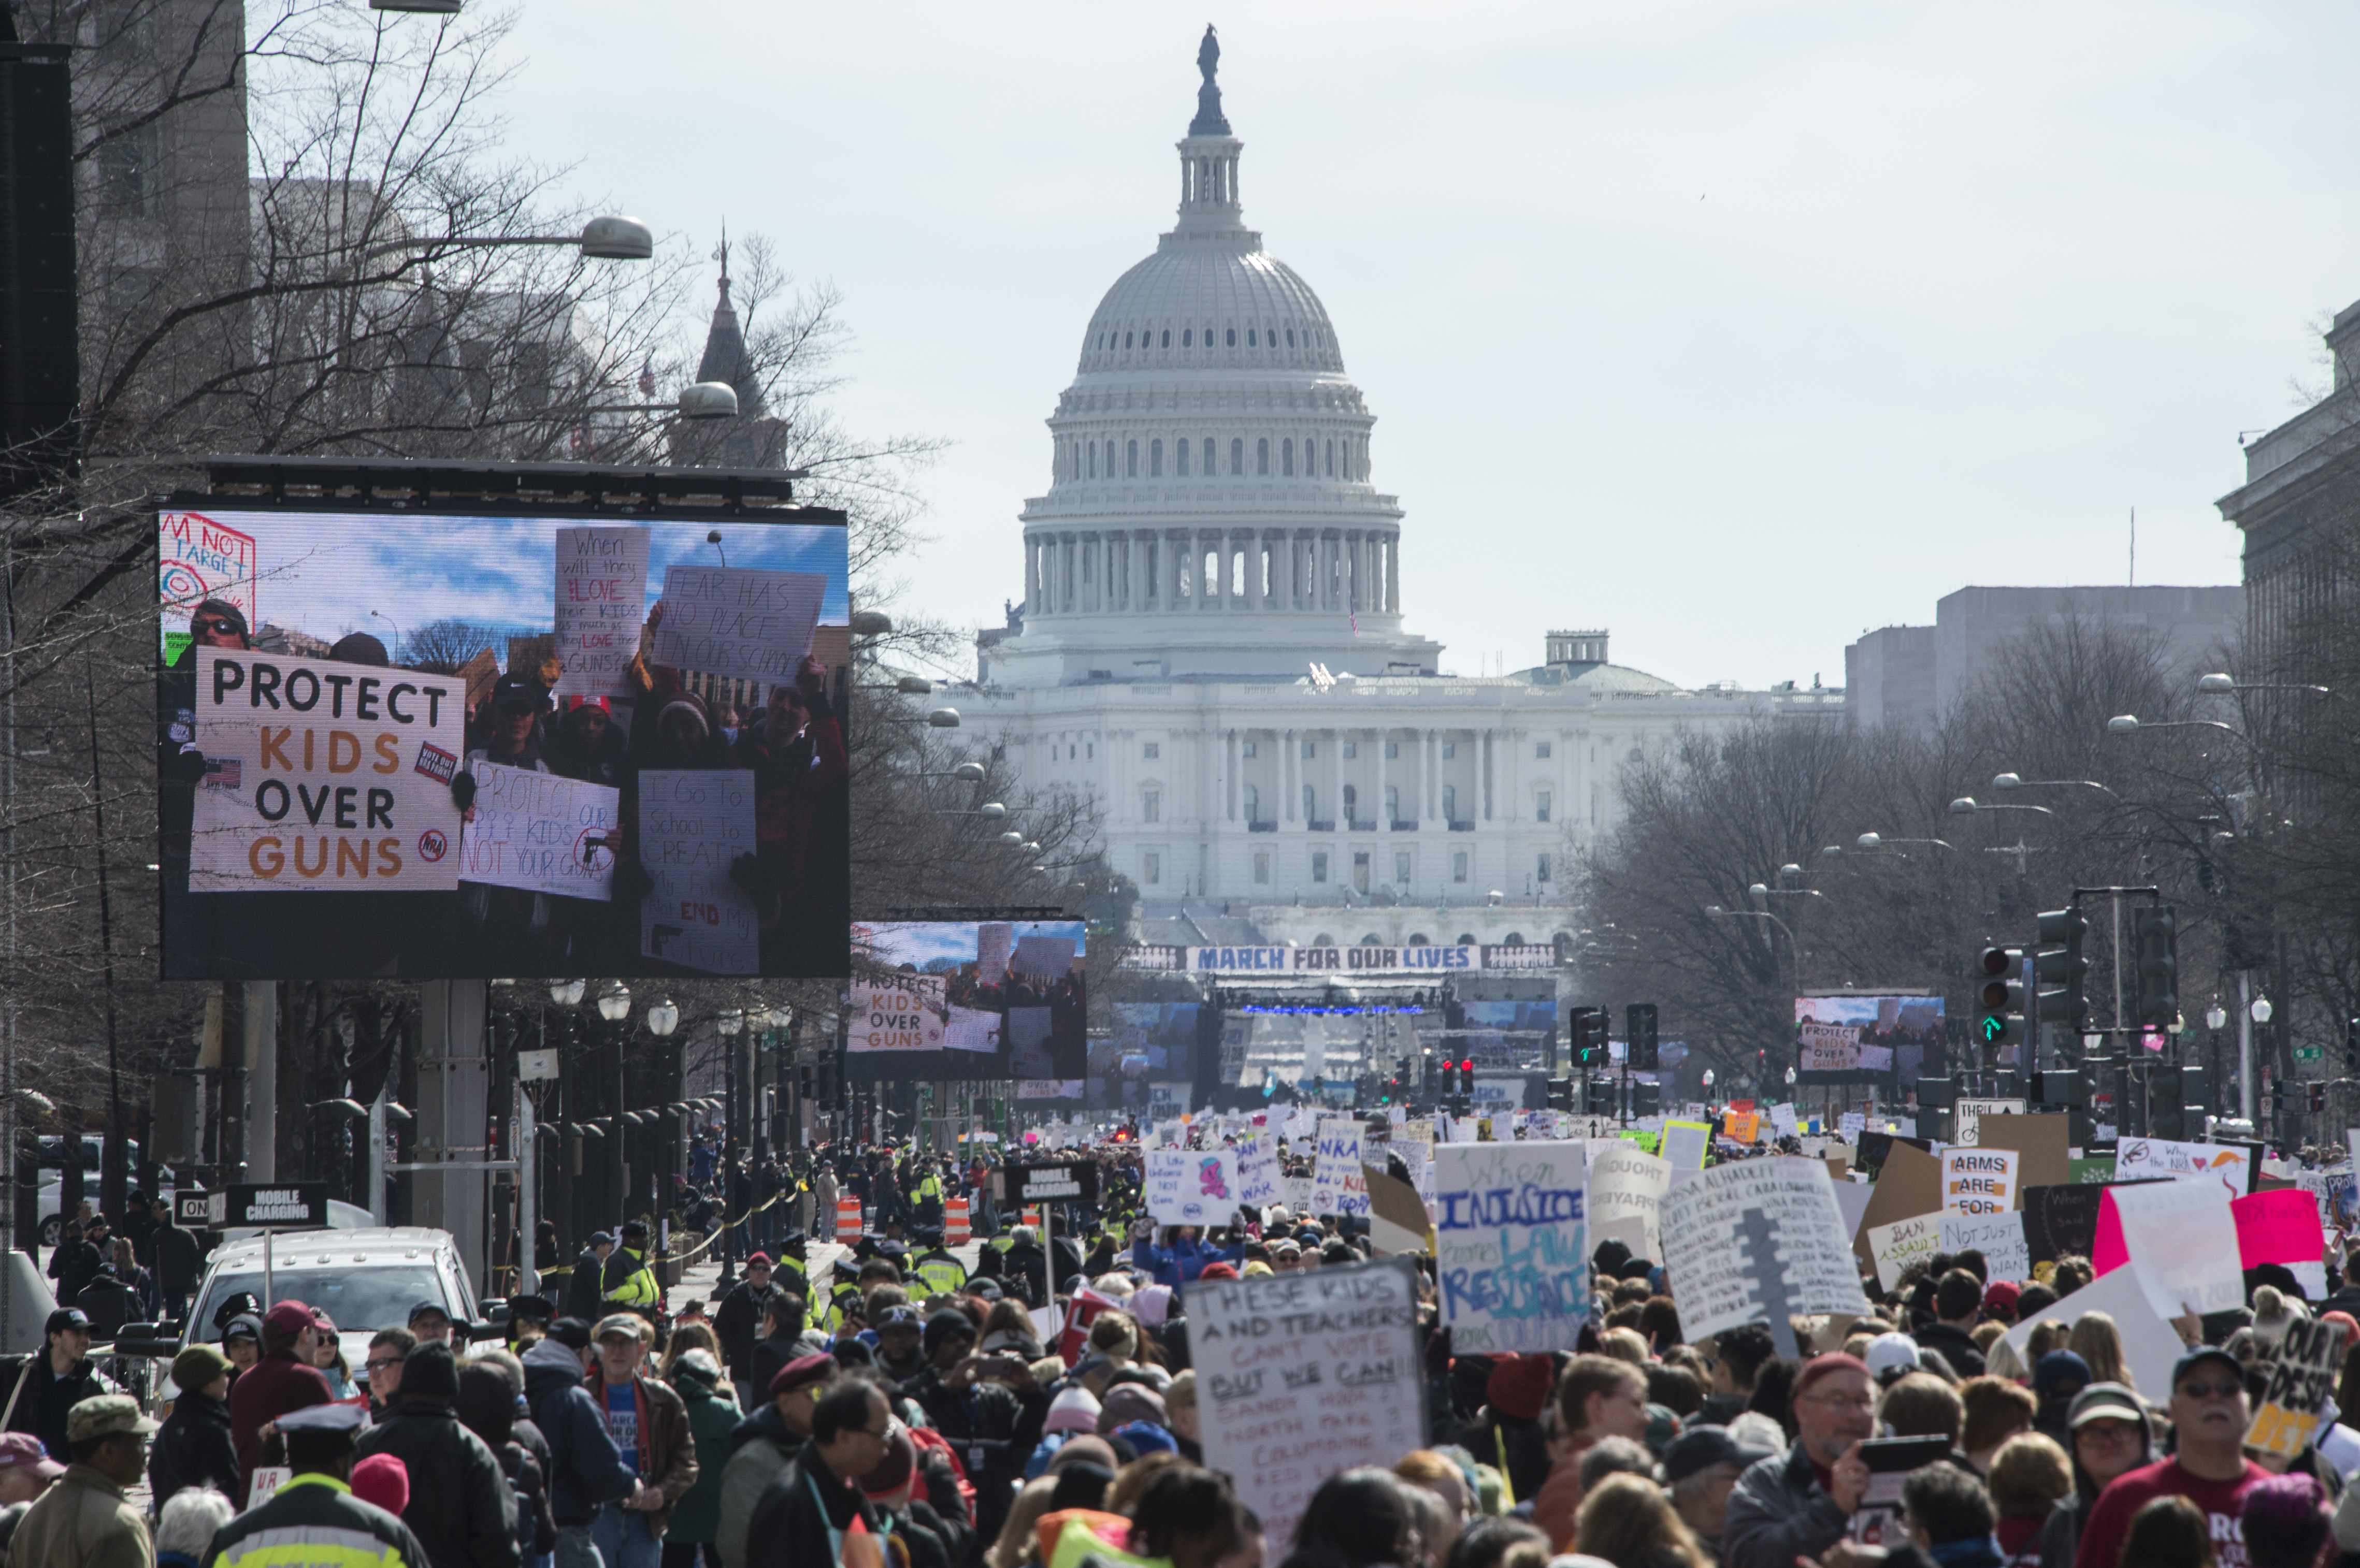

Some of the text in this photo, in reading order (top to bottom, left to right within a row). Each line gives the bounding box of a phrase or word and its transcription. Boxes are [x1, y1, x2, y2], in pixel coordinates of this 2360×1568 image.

[202, 526, 251, 564] NOT
[573, 529, 624, 557] When
[170, 537, 247, 579] TARGET
[562, 559, 636, 583] will they
[571, 578, 625, 602] LOVE
[668, 570, 789, 612] FEAR HAS
[599, 604, 637, 619] KIDS
[663, 601, 697, 626] NO
[710, 607, 780, 640] PLACE
[578, 619, 605, 630] much
[582, 633, 613, 648] LOVE
[660, 631, 690, 662] IN
[696, 638, 727, 667] OUR
[212, 659, 447, 727] PROTECT
[260, 727, 399, 774] KIDS
[423, 748, 454, 769] VOTE OUT
[476, 762, 582, 817] PROTECT
[645, 776, 668, 803] I
[256, 779, 394, 829] OVER
[579, 804, 608, 827] OUR
[527, 816, 573, 846] KIDS
[649, 809, 704, 834] School
[422, 835, 442, 853] NRA
[643, 840, 744, 867] CREATE
[249, 836, 402, 878] GUNS
[460, 839, 602, 880] NOT YOUR GUNS
[651, 869, 673, 896] My
[681, 901, 719, 925] END
[727, 908, 750, 939] My
[1198, 947, 1470, 969] MARCH FOR OUR LIVES
[855, 972, 941, 994] PROTECT
[872, 994, 923, 1011] KIDS
[871, 1012, 920, 1029] OVER
[868, 1032, 923, 1048] GUNS
[1805, 1027, 1855, 1039] PROTECT
[1815, 1038, 1846, 1048] KIDS
[1815, 1049, 1844, 1057] OVER
[1153, 1154, 1158, 1165] I
[1319, 1139, 1359, 1160] NRA
[2165, 1145, 2189, 1157] Why
[1459, 1149, 1564, 1187] When
[1954, 1156, 2005, 1171] ARMS
[2150, 1156, 2164, 1168] the
[2170, 1158, 2191, 1170] NRA
[1029, 1167, 1071, 1184] MOBILE
[1158, 1181, 1177, 1191] NOT
[1316, 1172, 1331, 1184] did
[1343, 1174, 1368, 1192] KIL
[1959, 1179, 1995, 1193] ARE
[255, 1190, 299, 1205] MOBILE
[1022, 1181, 1081, 1199] CHARGING
[1241, 1181, 1275, 1200] WAR
[1746, 1182, 1777, 1198] CARA
[2050, 1189, 2086, 1206] When
[246, 1204, 309, 1221] CHARGING
[1959, 1200, 1994, 1214] FOR
[1891, 1220, 1925, 1243] BAN
[1945, 1223, 2017, 1246] NOT JUST
[1500, 1224, 1584, 1266] LAW
[1879, 1234, 1940, 1262] ASSAULT
[1198, 1276, 1391, 1315] THESE KIDS
[1202, 1307, 1412, 1342] AND TEACHERS
[1231, 1331, 1389, 1367] CAN'T VOTE
[2283, 1318, 2328, 1366] OUR
[1208, 1367, 1268, 1397] BUT
[1282, 1362, 1321, 1388] WE
